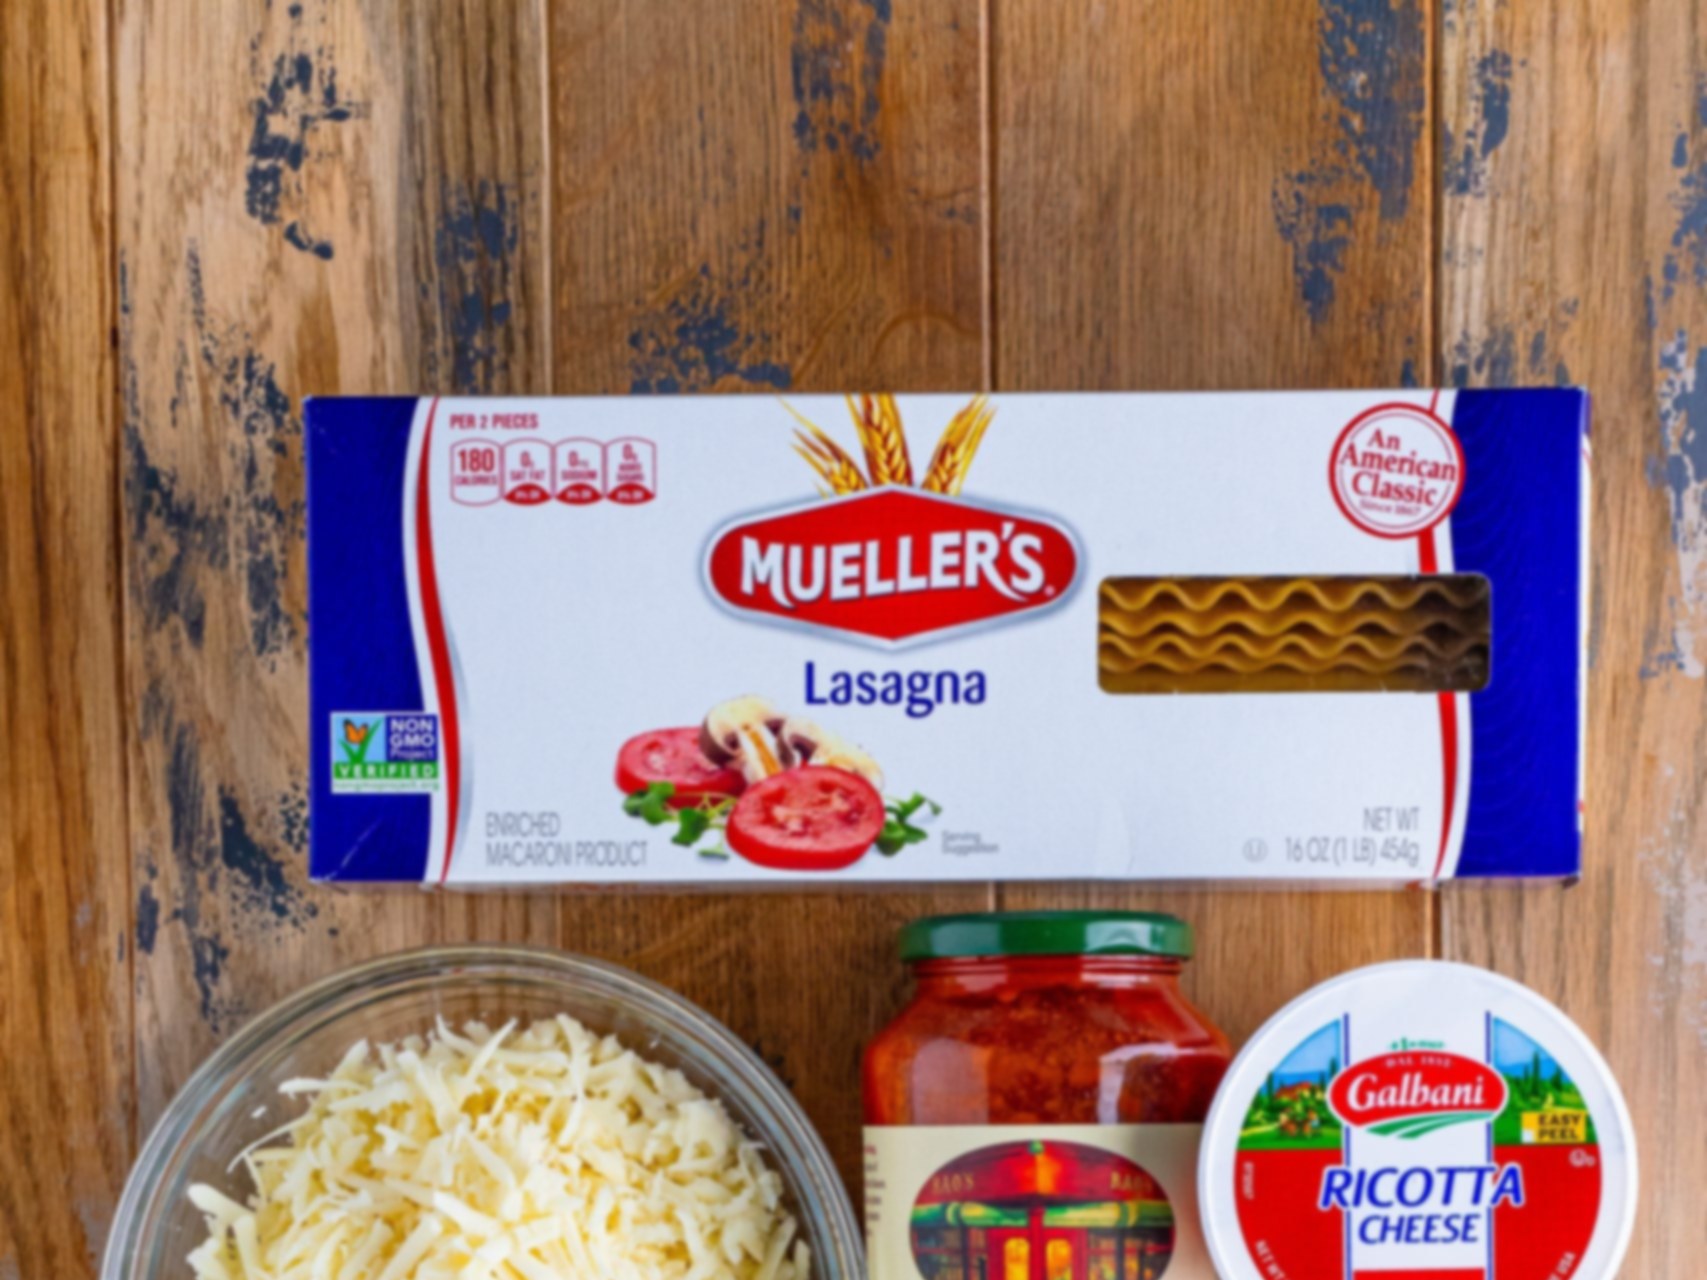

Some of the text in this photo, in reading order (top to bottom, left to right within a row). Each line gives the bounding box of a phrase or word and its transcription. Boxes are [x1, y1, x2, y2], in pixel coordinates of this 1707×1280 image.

[450, 414, 538, 429] PER 2 PIECES
[1367, 427, 1400, 451] An
[458, 448, 494, 472] 180
[1340, 442, 1456, 482] American
[454, 475, 497, 486] CALORIES
[1351, 471, 1437, 507] Classic
[740, 522, 1045, 608] MUELLER'S
[805, 661, 987, 718] Lasagna
[391, 719, 433, 731] NON
[390, 733, 434, 748] GMO
[391, 749, 434, 760] Project
[340, 765, 434, 778] VERIFIED
[486, 812, 560, 837] ENRICHED
[1363, 808, 1419, 831] NET WT
[486, 842, 646, 867] MACARONI PRODUCT
[1286, 837, 1419, 868] 16 OZ (1 LB) 454g
[1346, 1073, 1486, 1112] Galbani
[1538, 1114, 1581, 1125] EASY
[1538, 1128, 1580, 1140] PEEL
[1320, 1165, 1524, 1209] RICOTTA
[1358, 1214, 1480, 1244] CHEESE
[1557, 1251, 1576, 1275] USA
